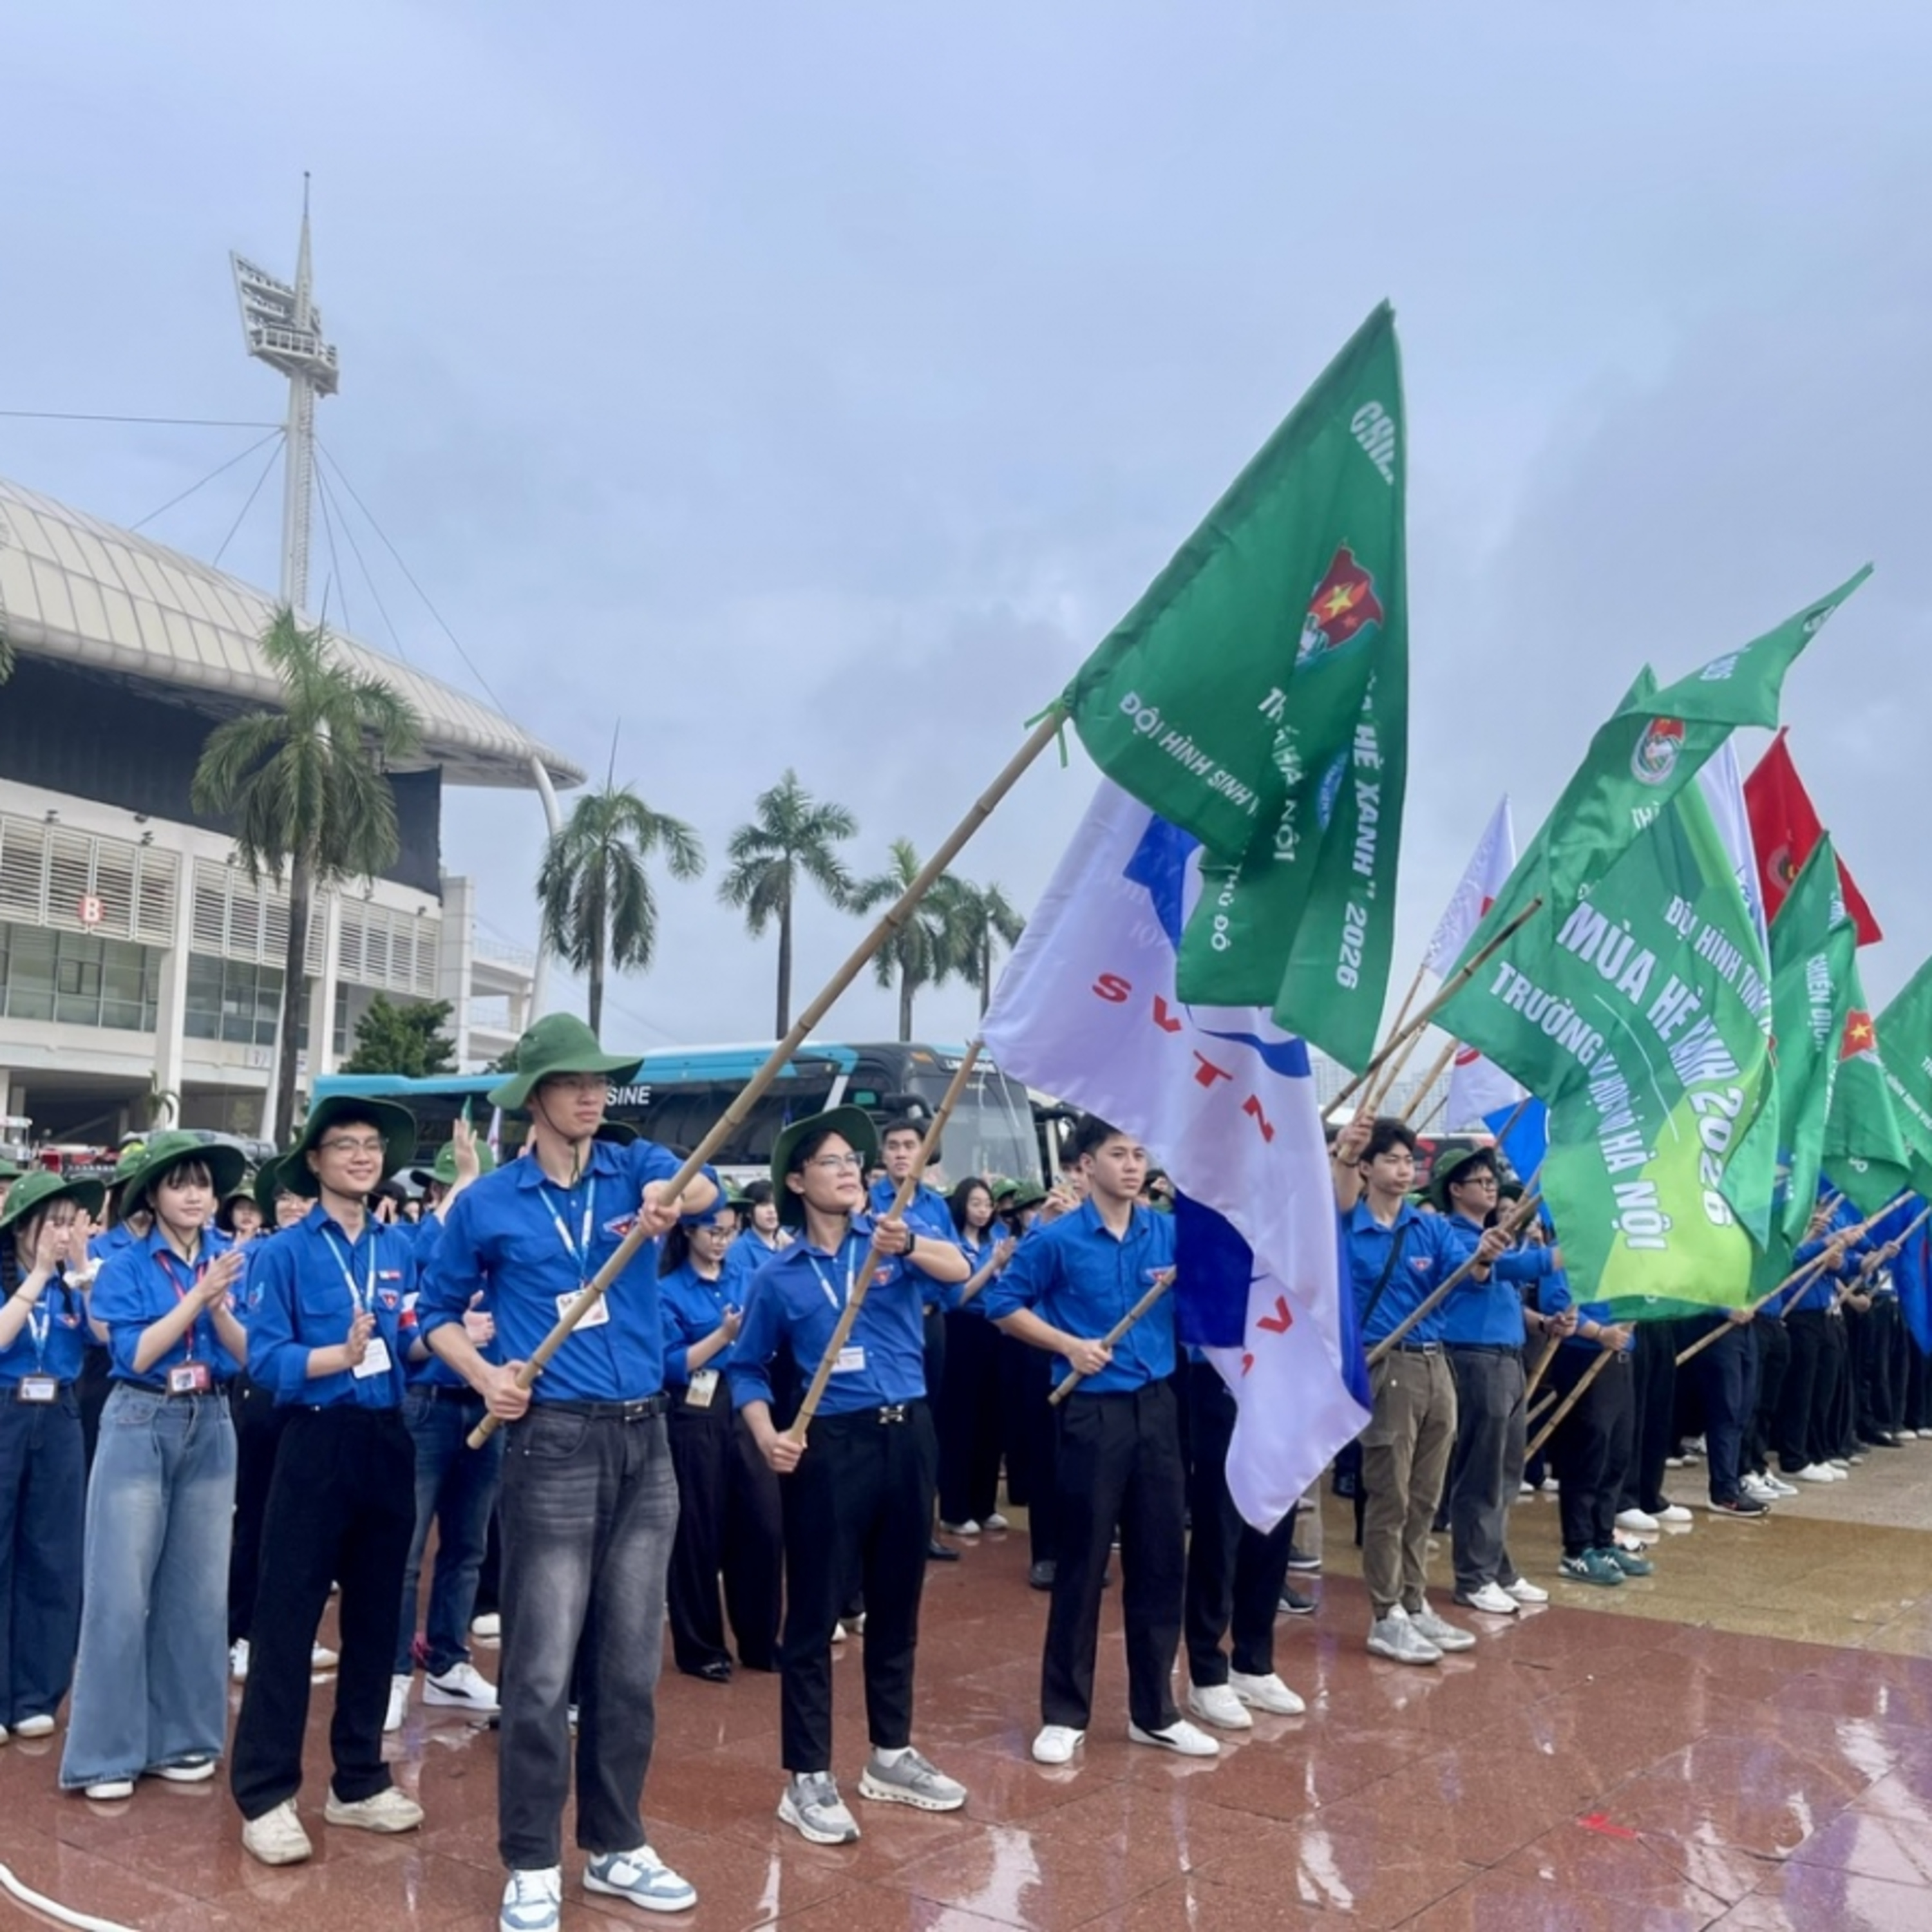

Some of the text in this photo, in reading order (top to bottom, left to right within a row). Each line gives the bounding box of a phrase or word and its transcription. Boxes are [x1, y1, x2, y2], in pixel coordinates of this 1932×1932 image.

[1119, 690, 1254, 806] ĐỘI HÌNH SINH
[1353, 724, 1384, 770] HÈ
[84, 897, 99, 921] B
[1336, 902, 1367, 990] 2026
[1694, 923, 1742, 983] HÌNH
[1489, 960, 1604, 1066] TRƯỜNG
[1611, 1180, 1672, 1249] NỘI
[1556, 901, 1656, 1005] MÙA
[1646, 974, 1703, 1042] HÈ
[1690, 1087, 1745, 1227] 2026
